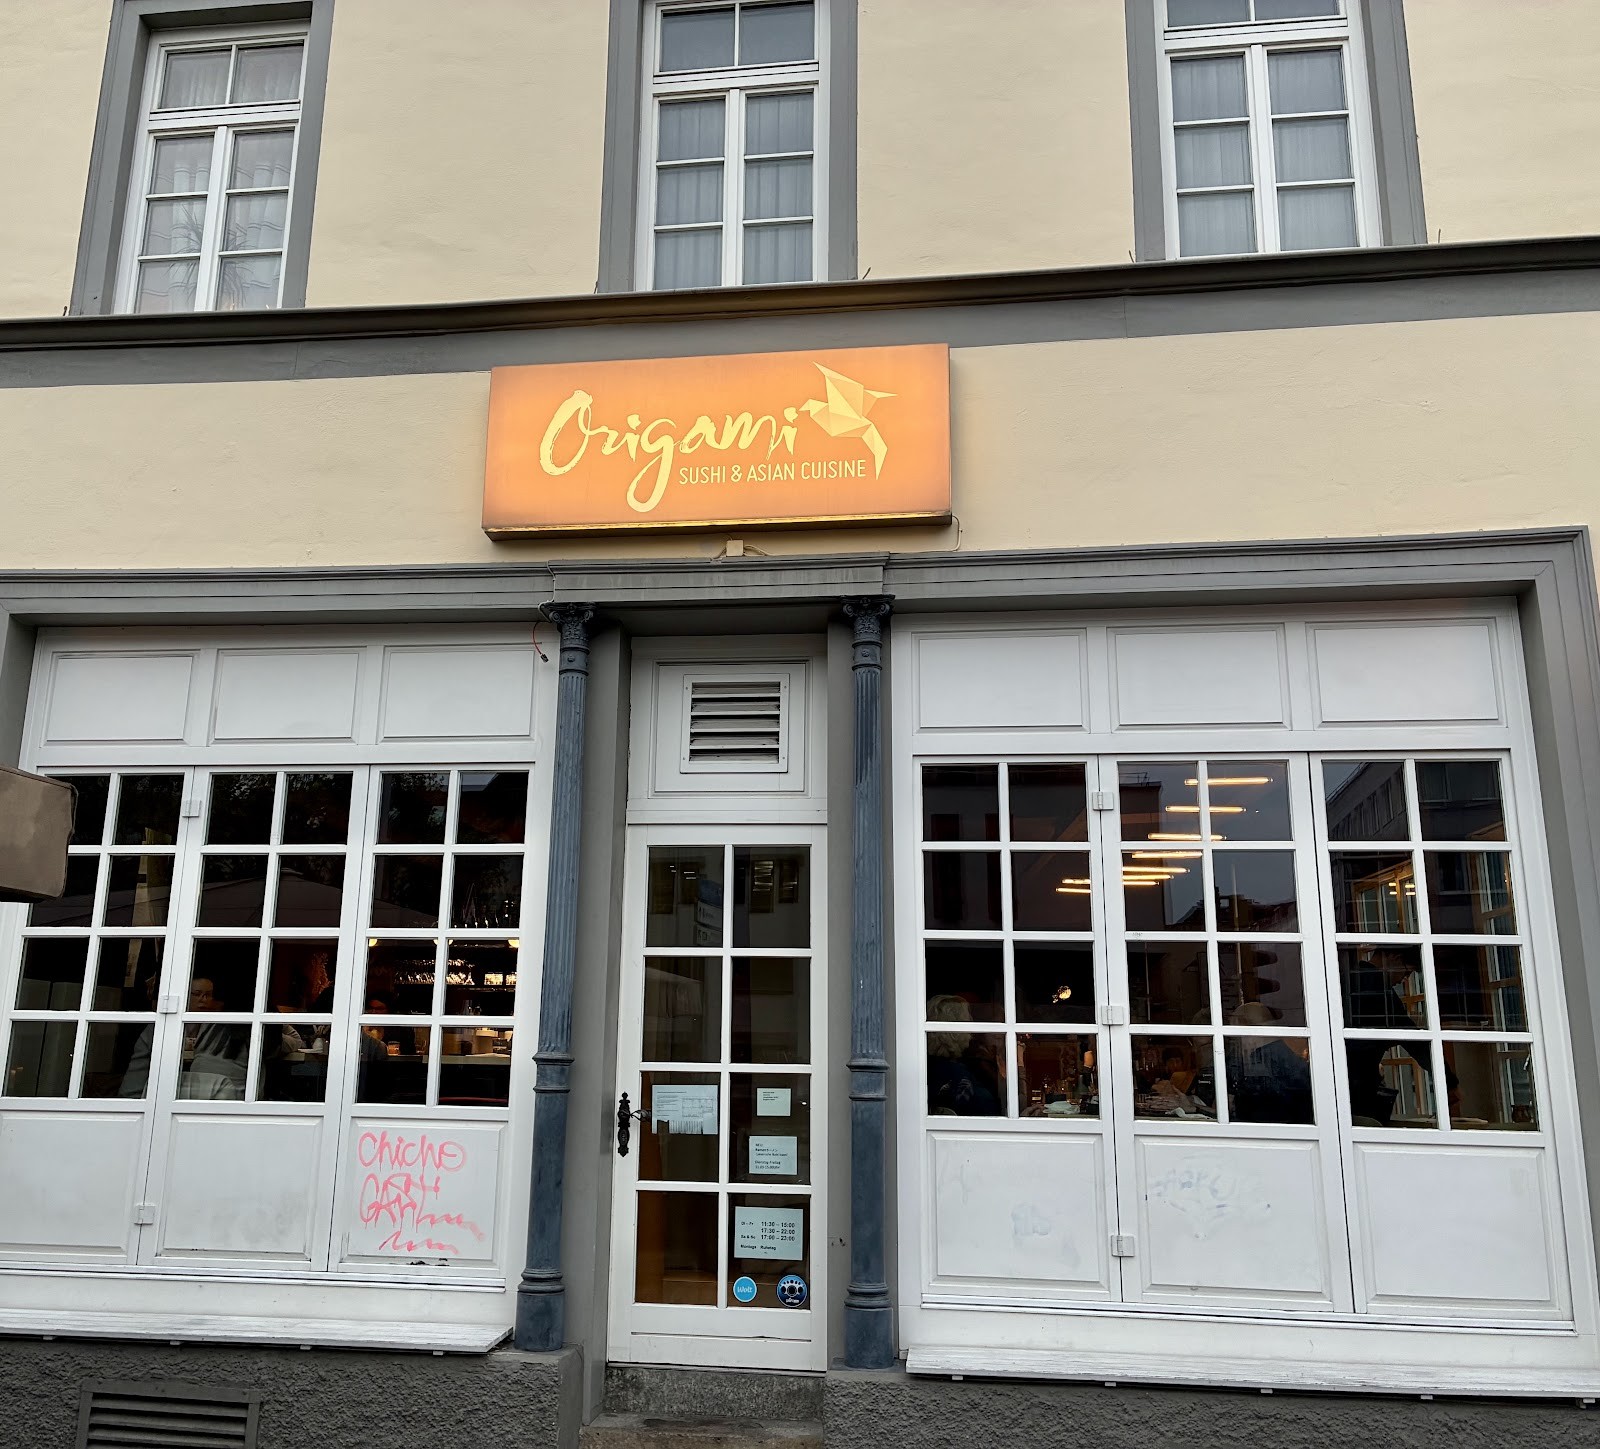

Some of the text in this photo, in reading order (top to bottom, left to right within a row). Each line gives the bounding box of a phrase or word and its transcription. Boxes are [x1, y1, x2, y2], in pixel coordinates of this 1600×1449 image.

[539, 389, 799, 513] Origami
[679, 459, 867, 485] SUSHI & ASIAN CUISINE
